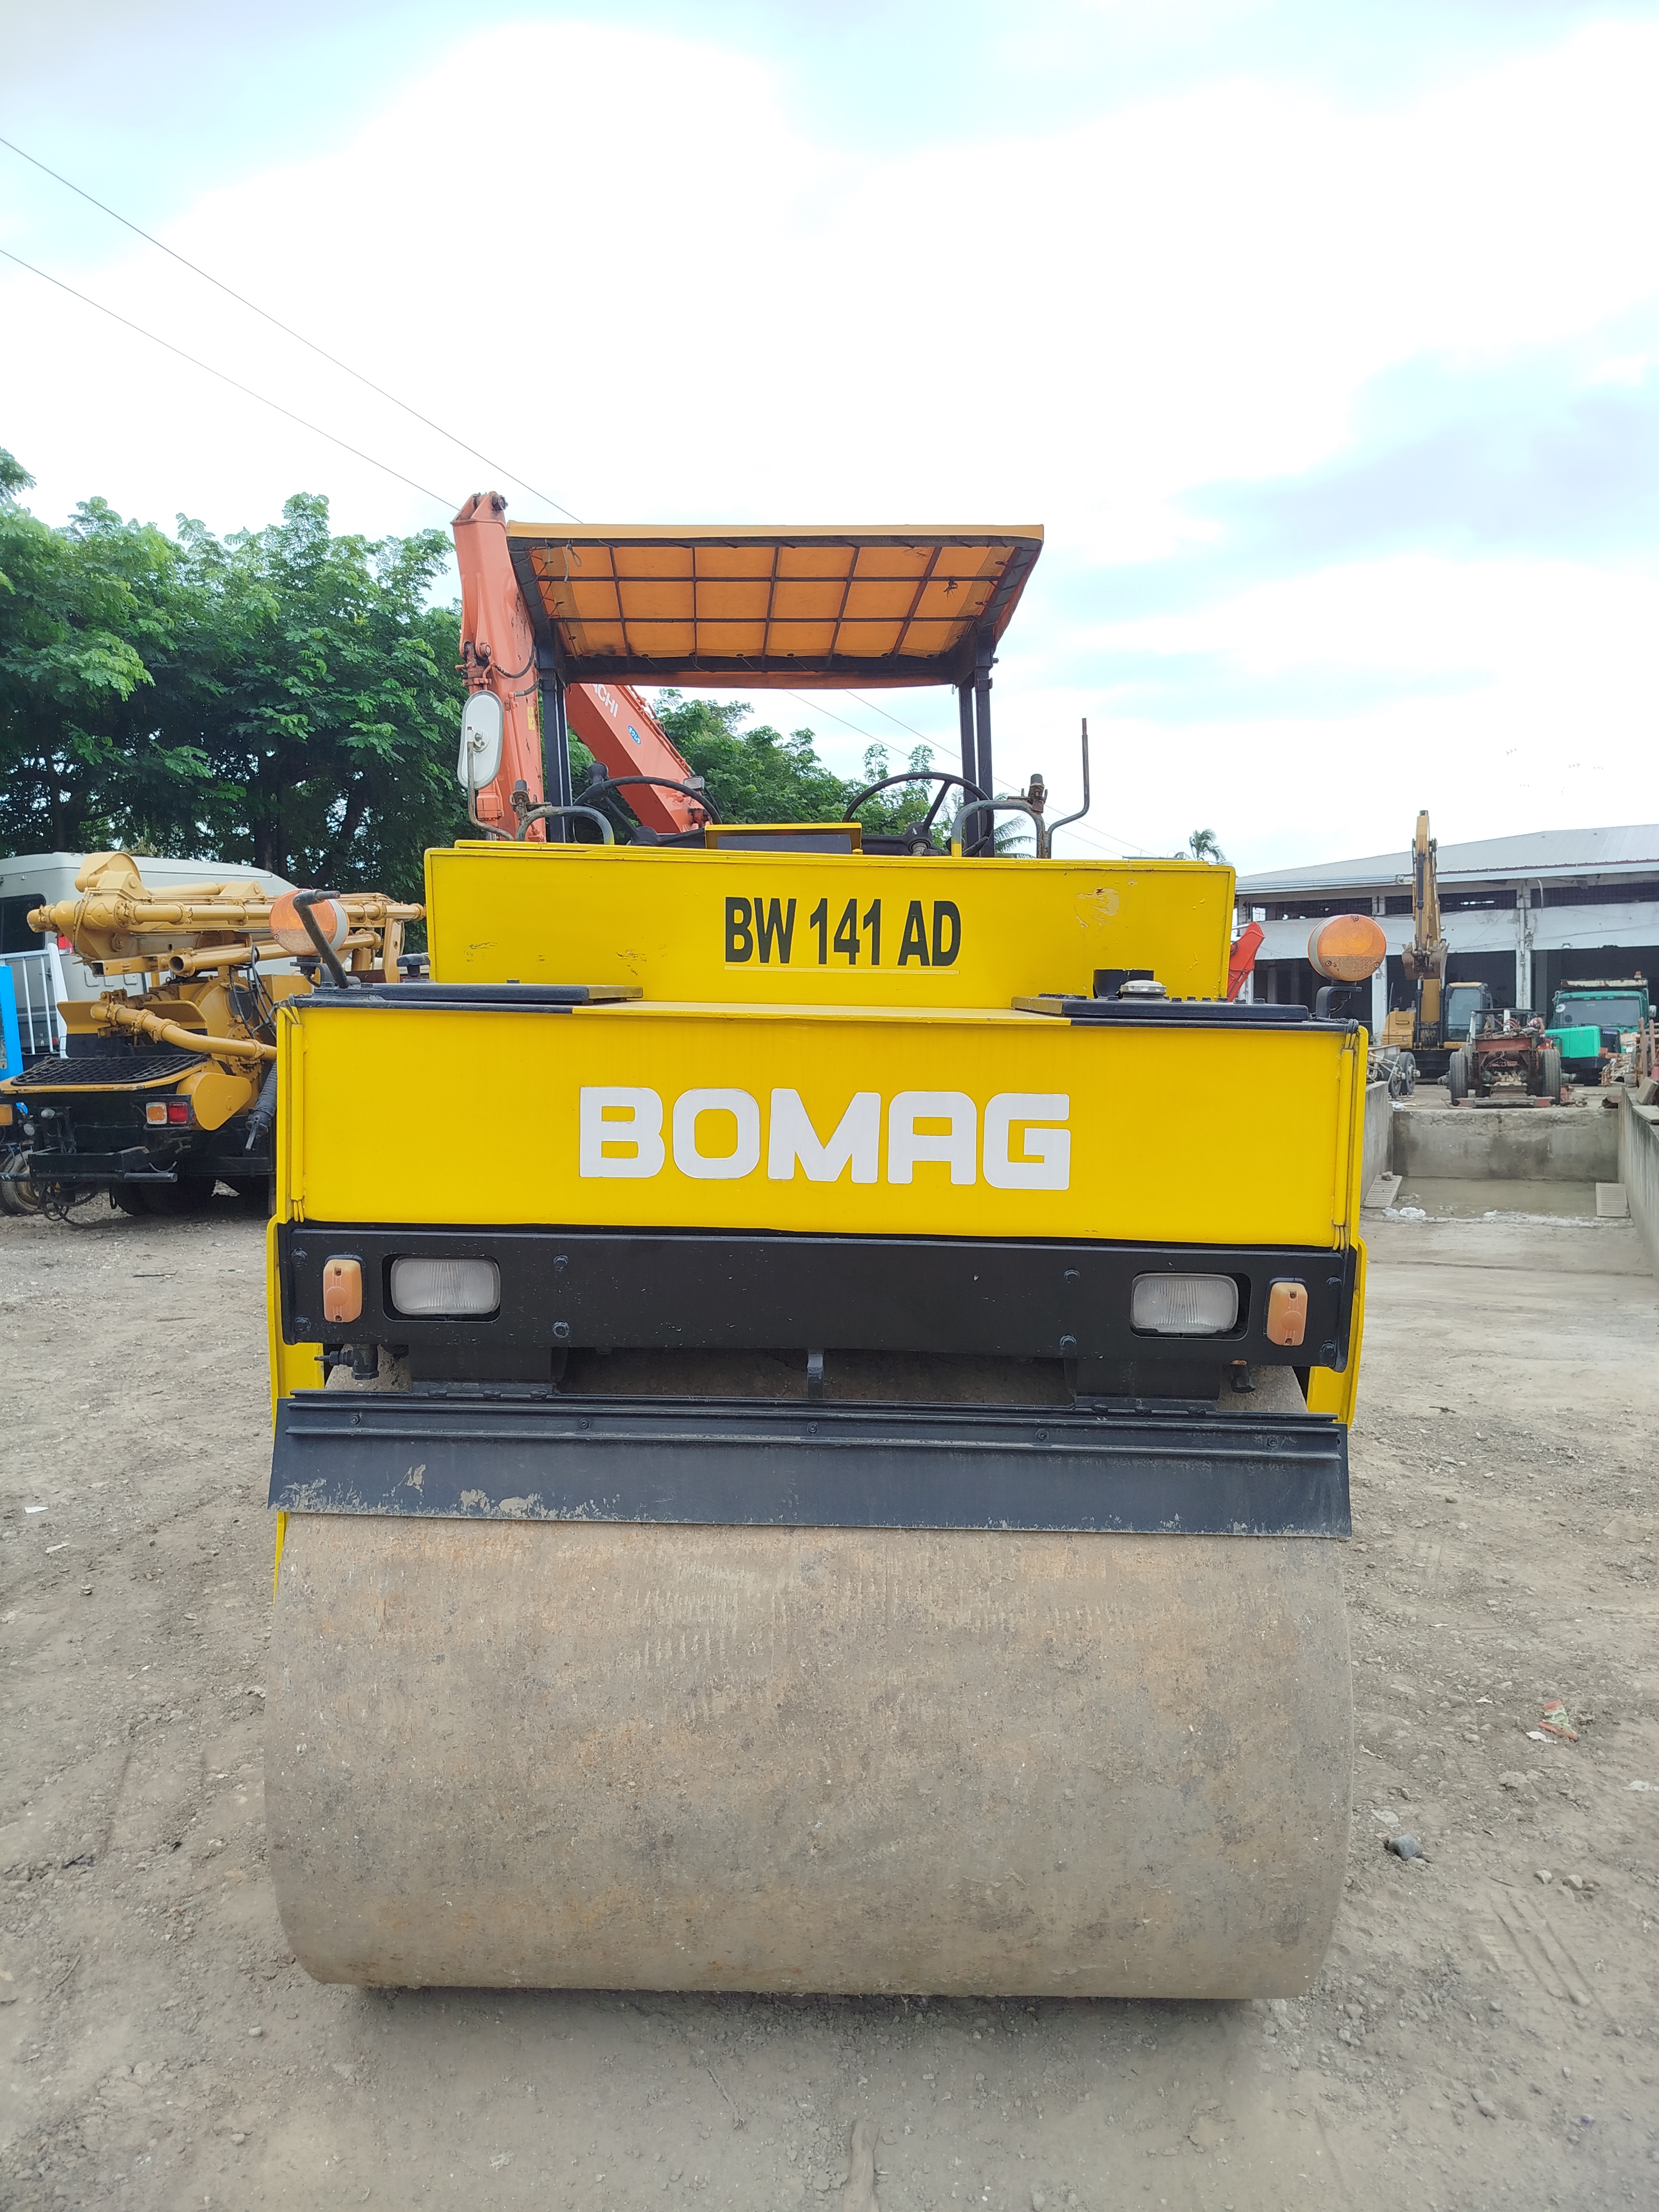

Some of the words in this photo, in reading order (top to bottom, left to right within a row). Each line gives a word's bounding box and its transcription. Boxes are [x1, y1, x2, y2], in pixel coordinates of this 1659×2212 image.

[725, 896, 797, 964] BW
[810, 898, 881, 966] 141
[897, 900, 961, 967] AD
[579, 1086, 1071, 1191] BOMAG
